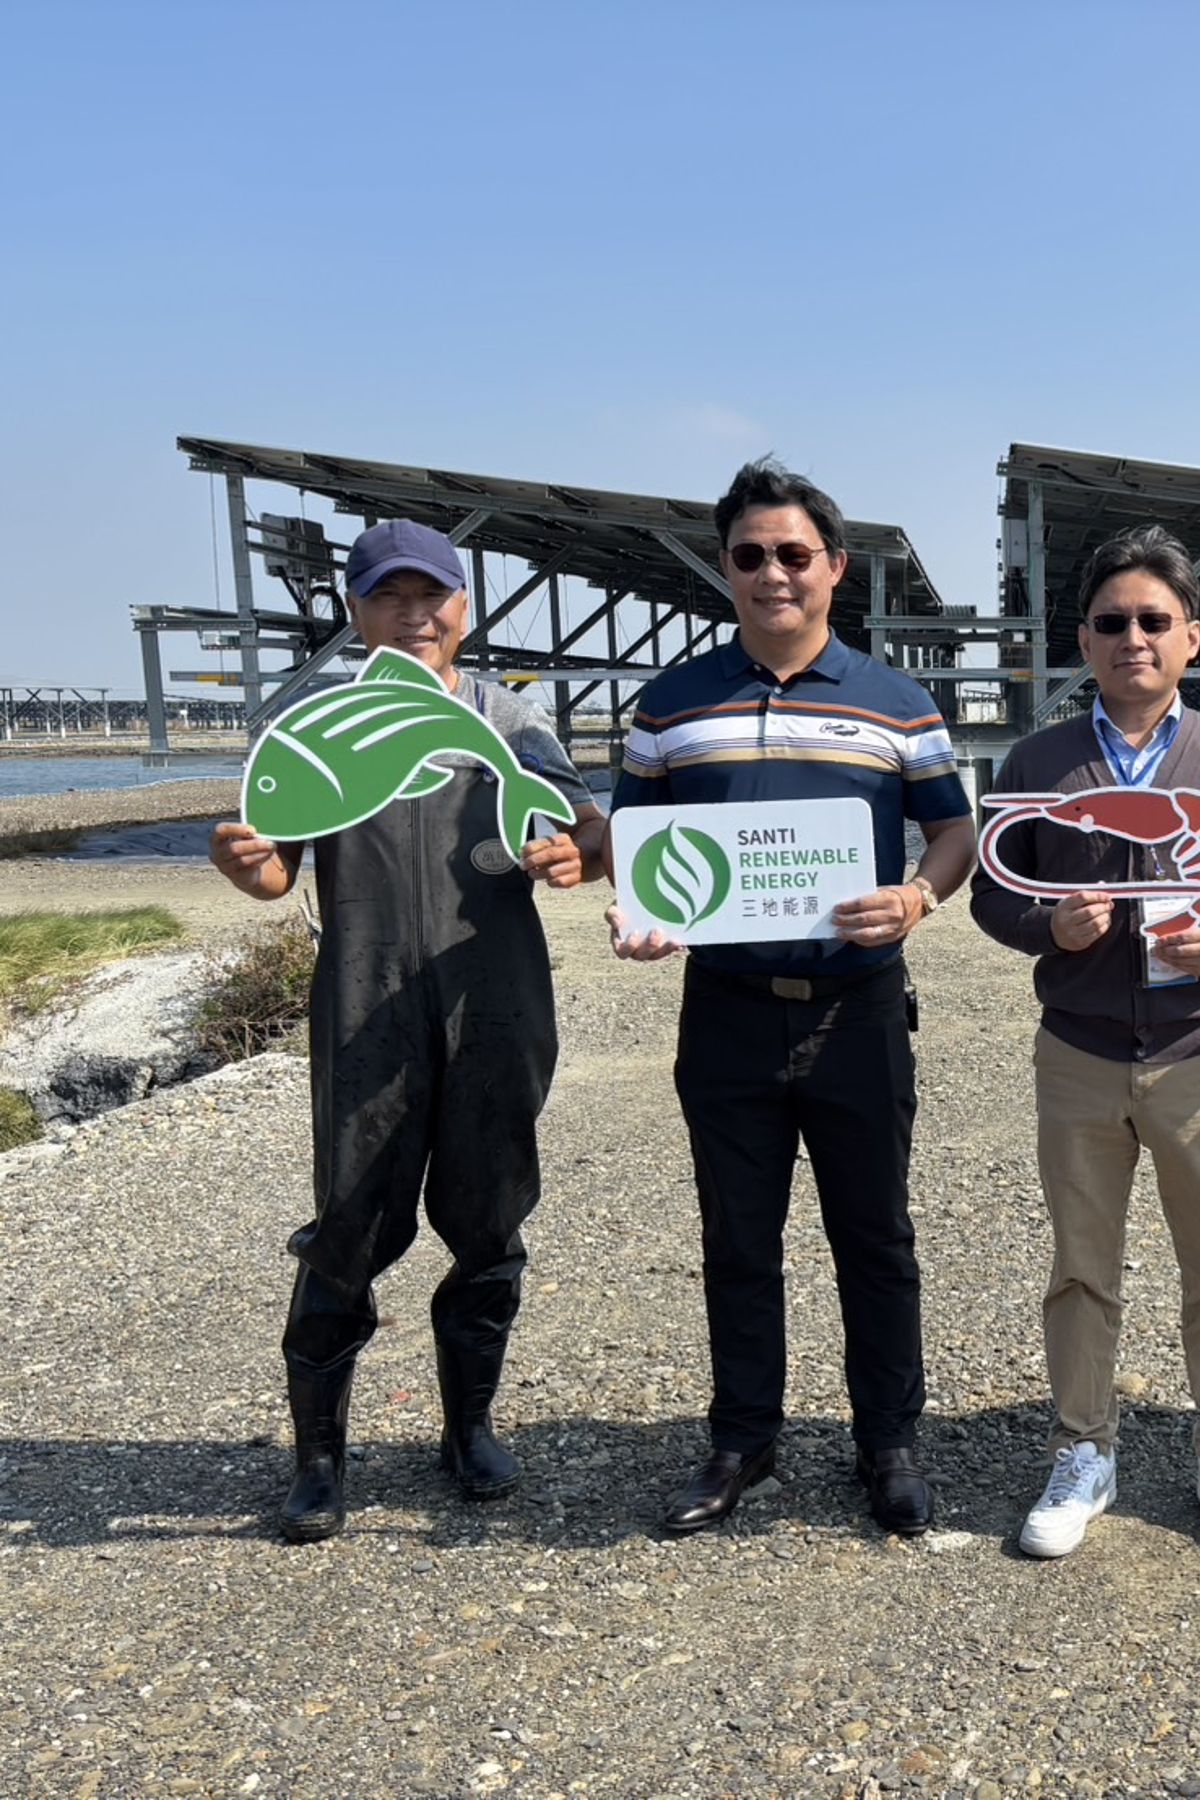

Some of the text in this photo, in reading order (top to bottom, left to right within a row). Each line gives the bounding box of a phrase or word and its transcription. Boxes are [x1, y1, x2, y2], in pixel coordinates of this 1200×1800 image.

[737, 828, 796, 846] SANTI
[739, 847, 859, 868] RENEWABLE
[741, 871, 819, 890] ENERGY
[741, 895, 819, 917] 三地能源
